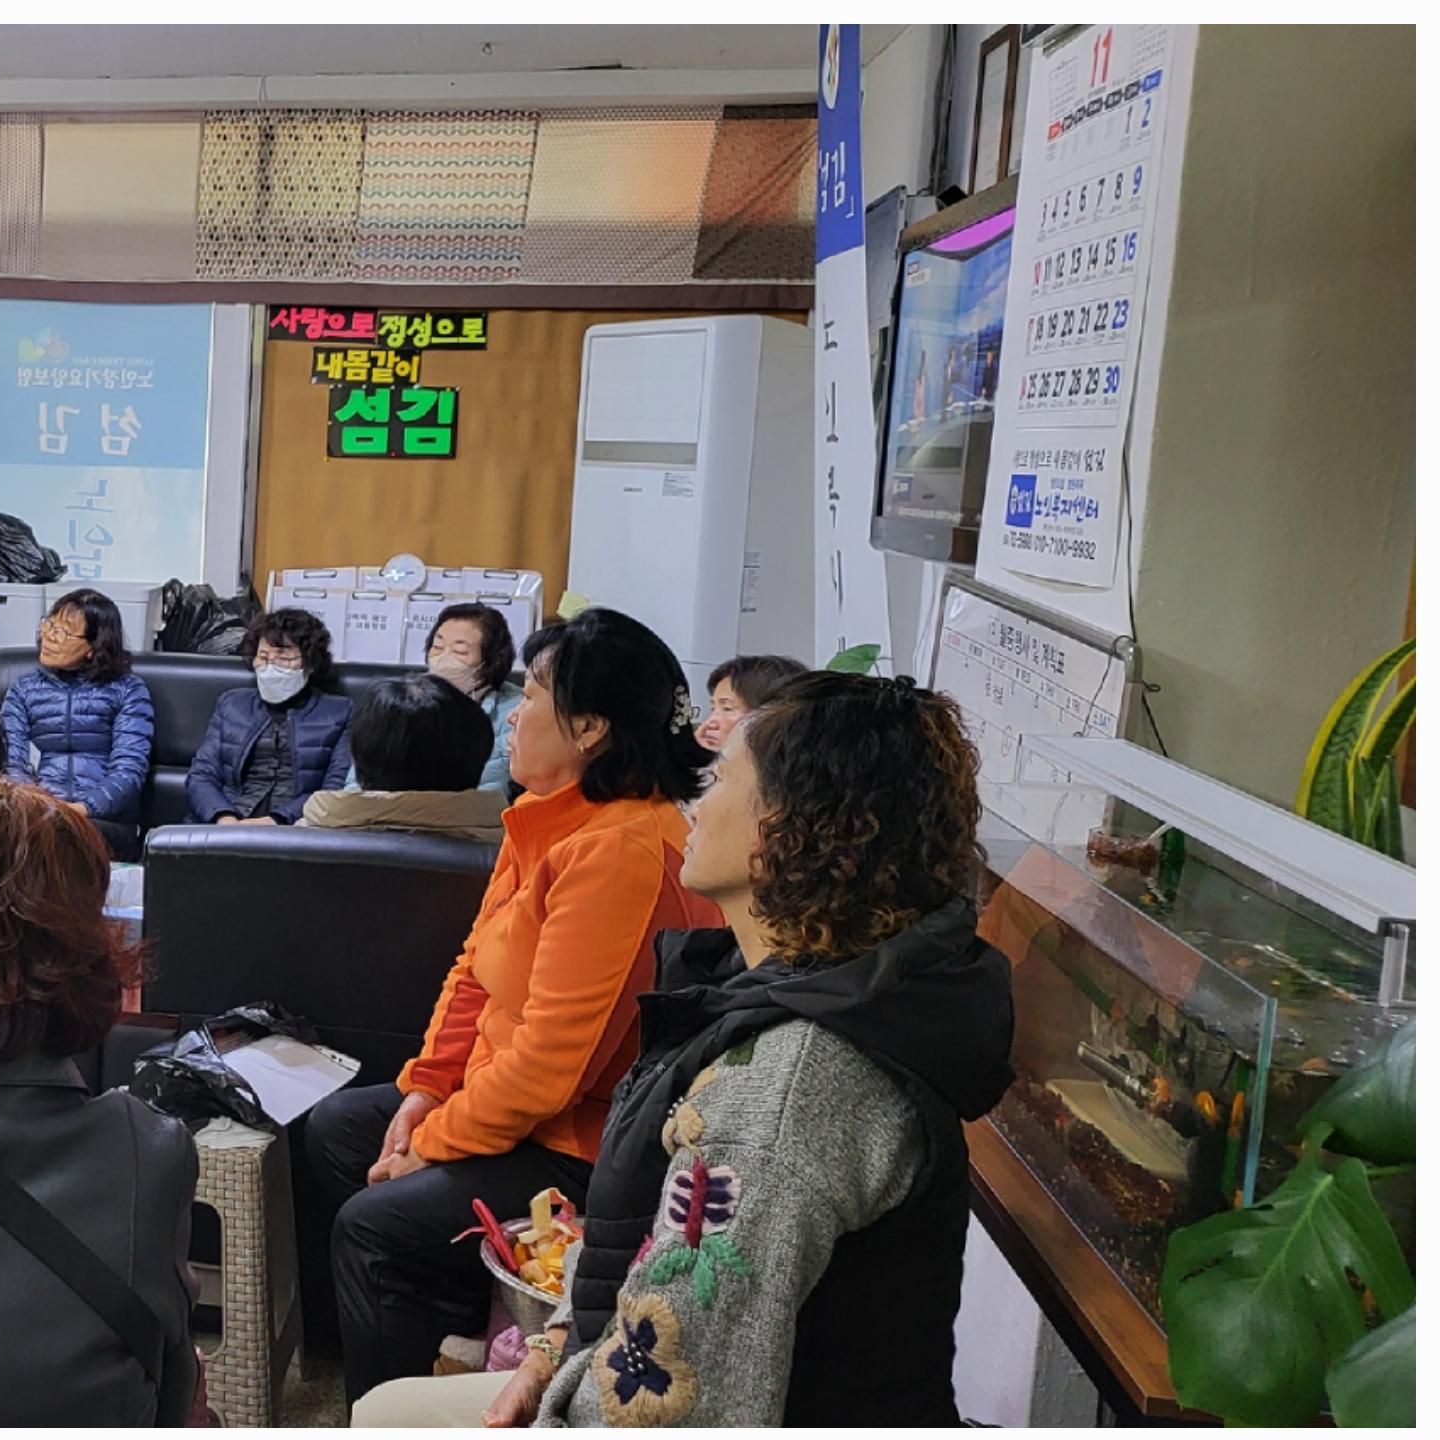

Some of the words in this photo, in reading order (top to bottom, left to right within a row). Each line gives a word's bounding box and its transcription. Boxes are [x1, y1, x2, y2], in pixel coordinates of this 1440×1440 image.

[1089, 27, 1113, 88] 11
[1141, 97, 1151, 128] 2
[1078, 184, 1087, 212] 6
[1095, 178, 1105, 207] 7
[1114, 173, 1123, 200] 8
[1132, 165, 1142, 196] 9
[1070, 247, 1082, 275] 13
[1087, 242, 1100, 271] 14
[1104, 237, 1117, 267] 15
[1121, 231, 1138, 263] 16
[269, 308, 377, 341] 사랑으로
[378, 313, 487, 348] 정성으로
[1047, 311, 1058, 338] 19
[1060, 309, 1075, 338] 20
[1077, 306, 1090, 335] 21
[1093, 302, 1109, 332] 22
[1111, 299, 1130, 330] 23
[315, 349, 420, 384] 내몸같이
[1051, 370, 1066, 398] 27
[1068, 368, 1082, 396] 28
[1084, 367, 1100, 395] 29
[1103, 365, 1121, 395] 30
[335, 387, 453, 455] 섬김
